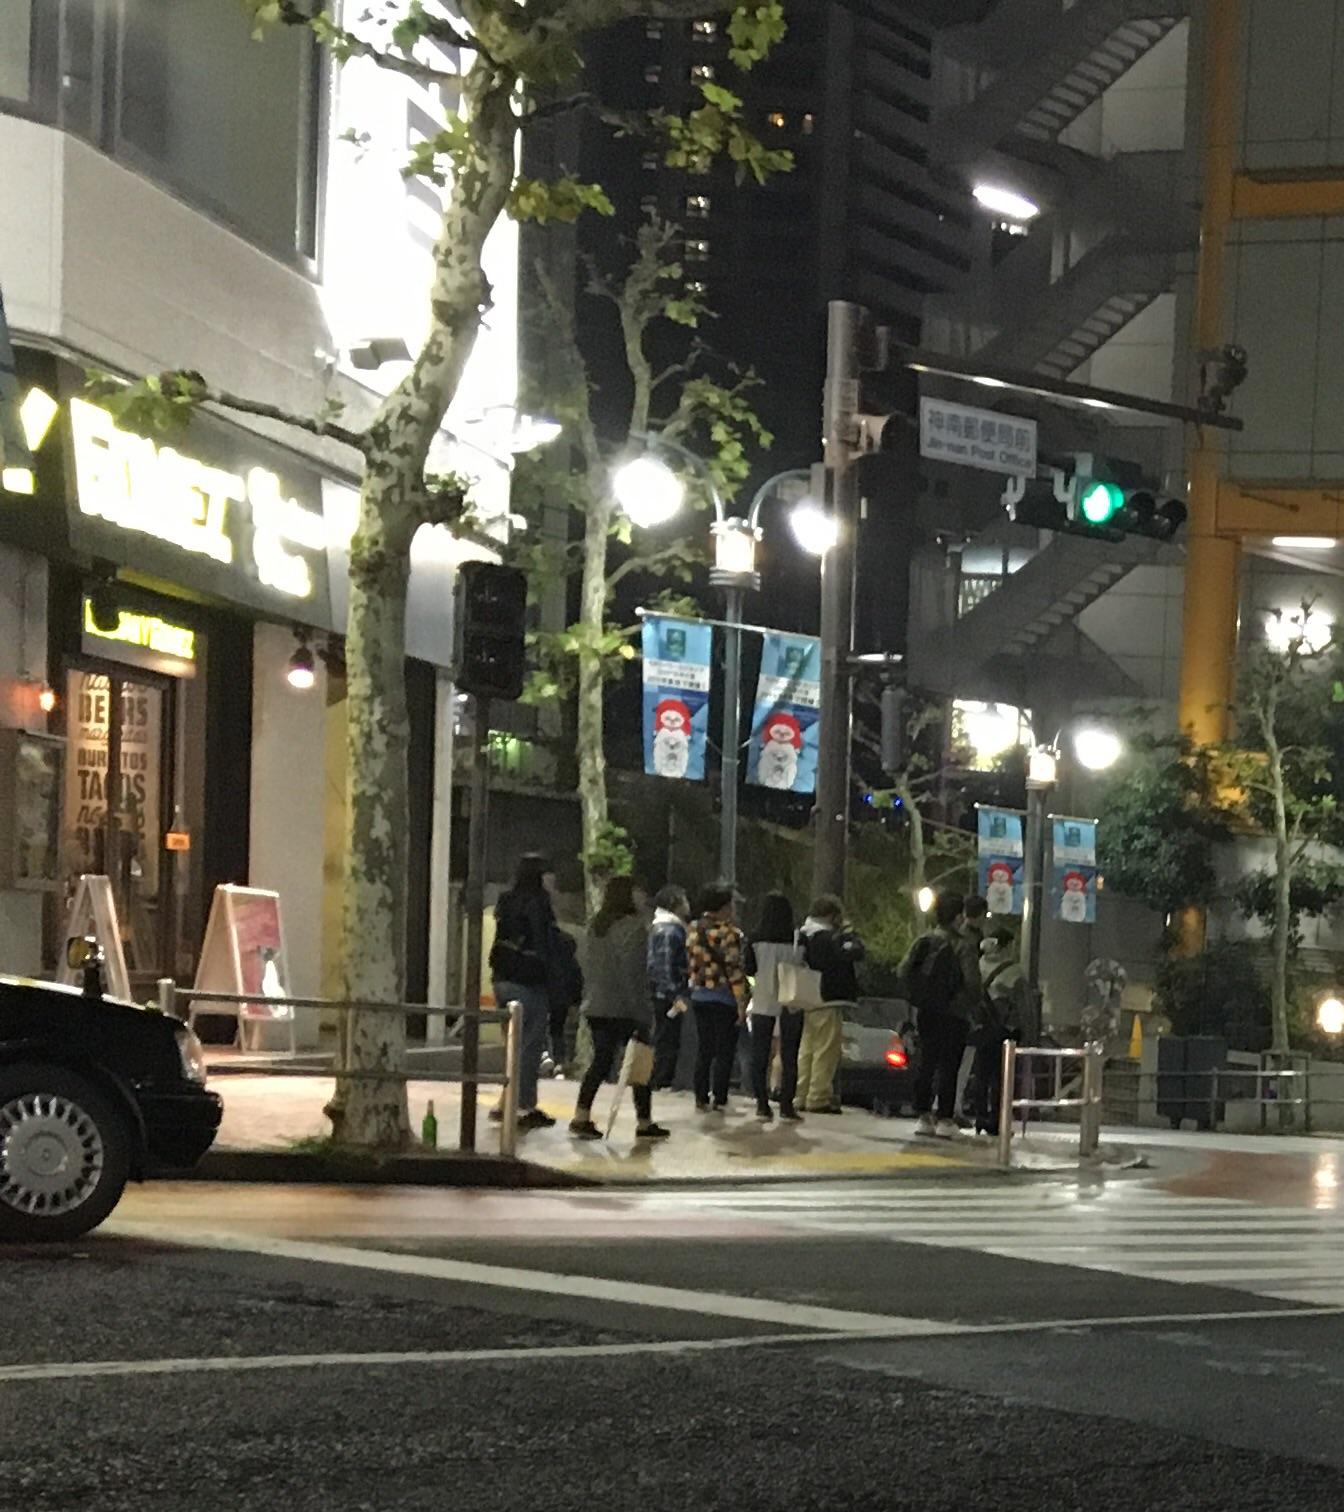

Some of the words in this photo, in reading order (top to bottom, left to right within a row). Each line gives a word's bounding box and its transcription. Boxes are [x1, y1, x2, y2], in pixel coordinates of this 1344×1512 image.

[970, 444, 996, 460] Post
[78, 693, 148, 727] BERS
[77, 747, 148, 770] BURTOS
[77, 769, 146, 804] TAOS
